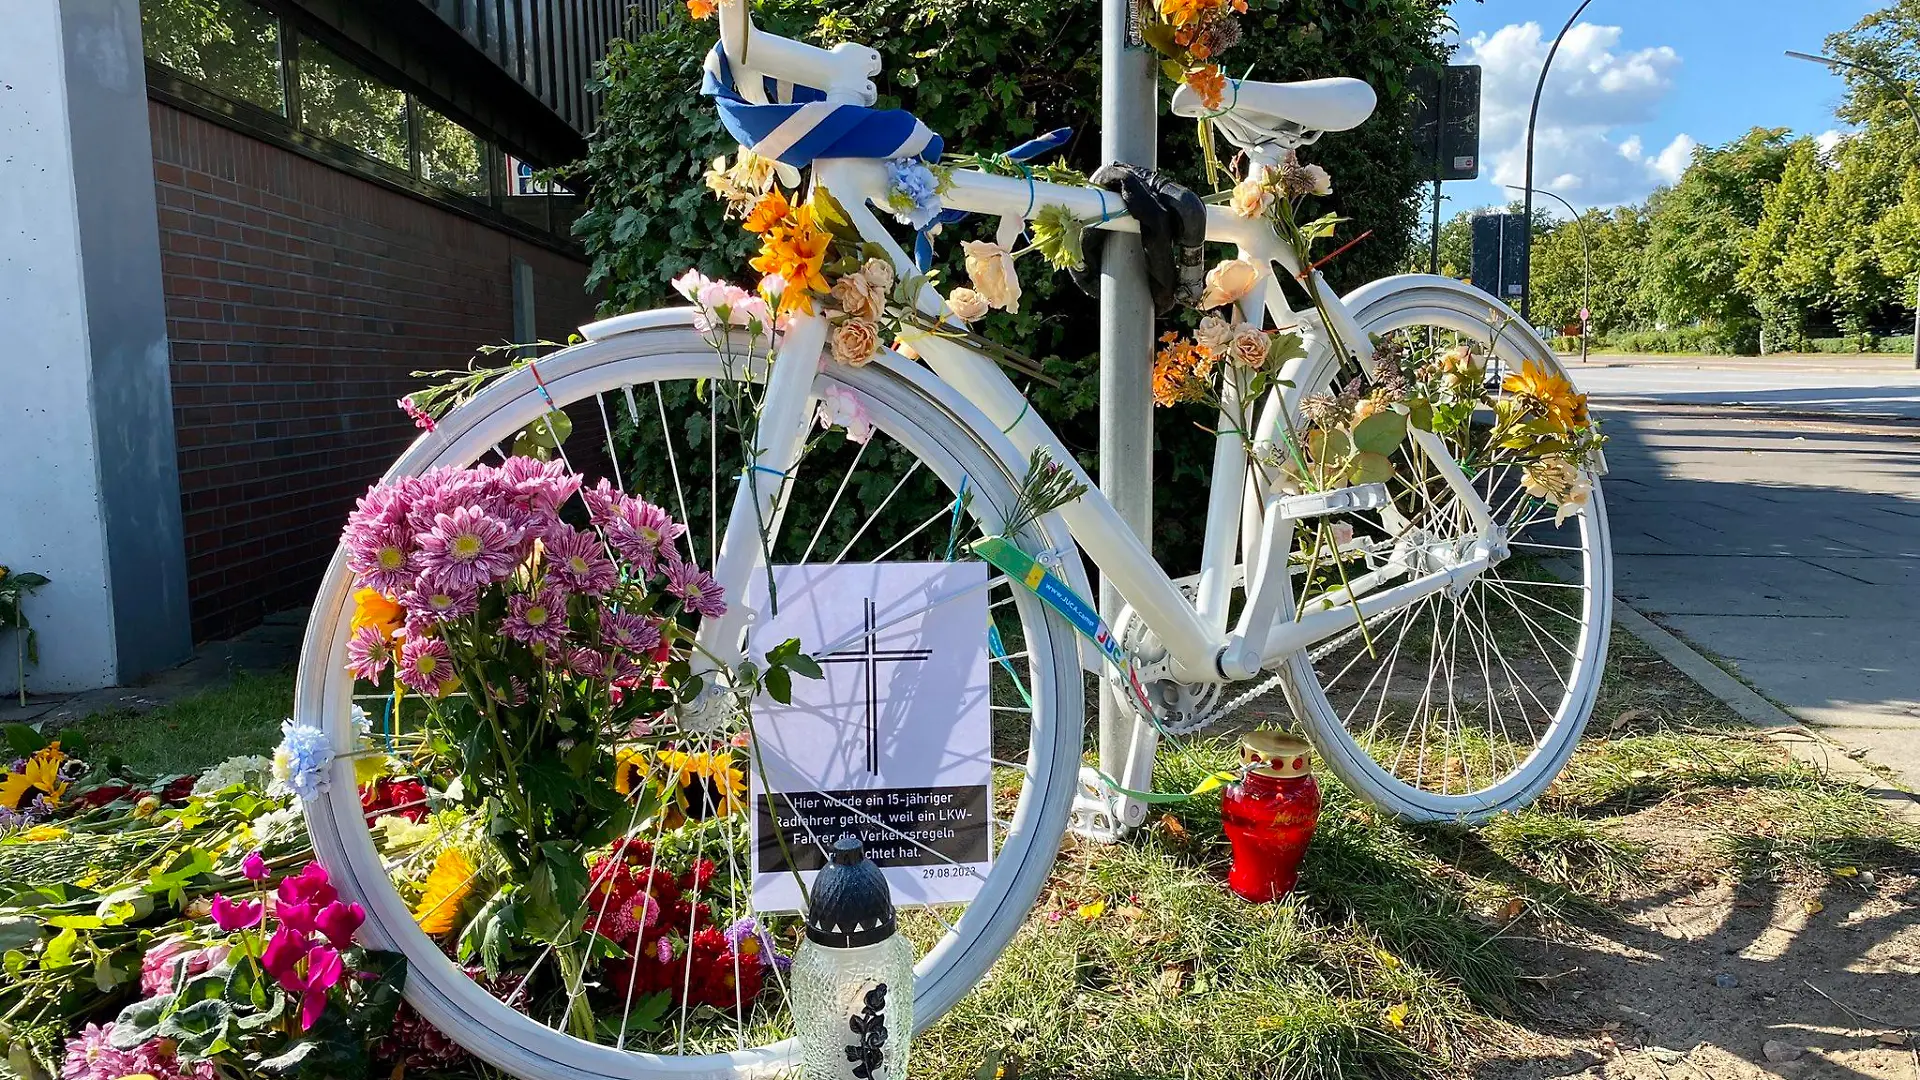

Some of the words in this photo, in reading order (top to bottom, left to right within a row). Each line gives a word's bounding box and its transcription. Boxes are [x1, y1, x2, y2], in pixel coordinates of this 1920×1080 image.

[794, 797, 820, 809] Hier
[823, 795, 862, 808] wurde
[865, 794, 884, 806] ein
[887, 792, 953, 807] 15-jähriger
[776, 814, 836, 827] Radfahrer
[888, 810, 914, 822] weil
[917, 810, 935, 821] ein
[939, 808, 973, 821] LKW-
[793, 833, 835, 845] Fahrer
[838, 831, 857, 839] die
[860, 827, 955, 841] Verkehrsregeln
[899, 846, 921, 857] hat.
[923, 866, 976, 879] 29.08.2023
